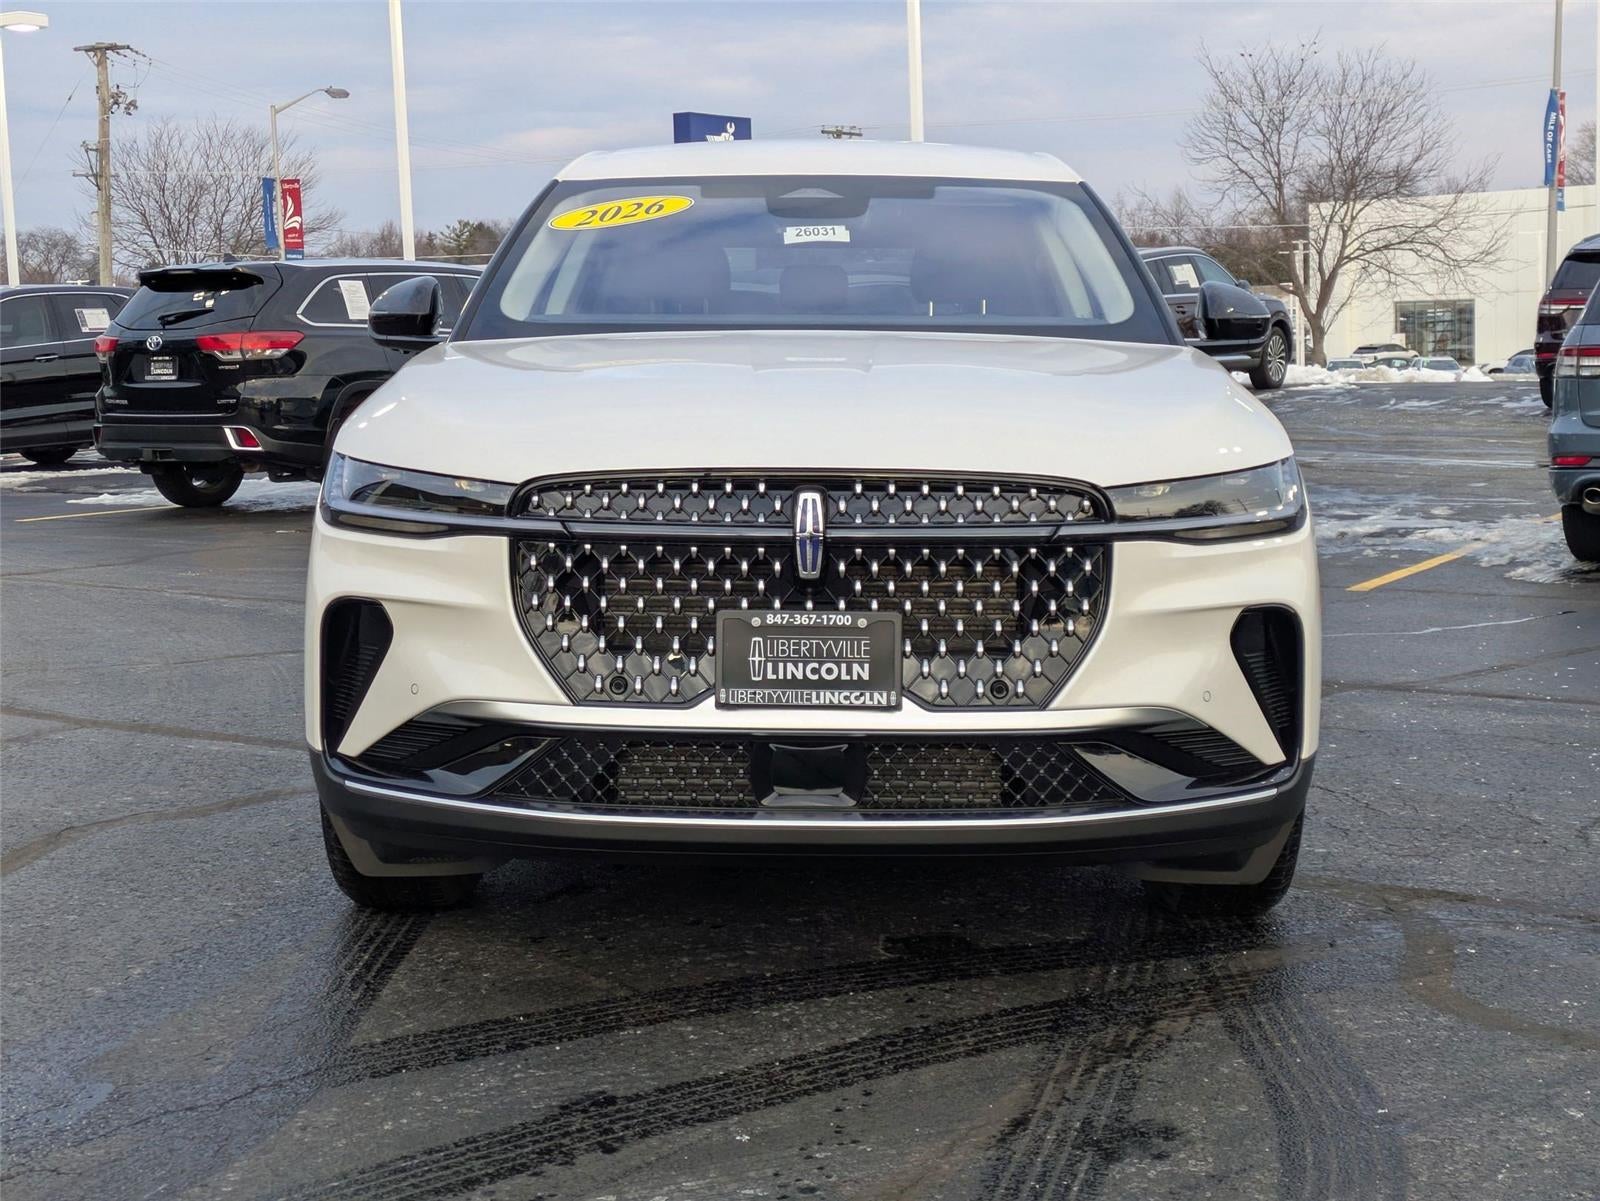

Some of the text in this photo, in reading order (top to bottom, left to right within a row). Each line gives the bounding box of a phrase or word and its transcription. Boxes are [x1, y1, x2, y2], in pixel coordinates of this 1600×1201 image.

[1548, 112, 1557, 130] MILE
[1547, 131, 1554, 141] OF
[574, 200, 667, 227] 2026
[795, 227, 837, 238] 26031
[766, 613, 852, 626] 847-367-1700
[767, 640, 870, 658] LIBERTYVILLE
[766, 662, 870, 681] LINCOLN
